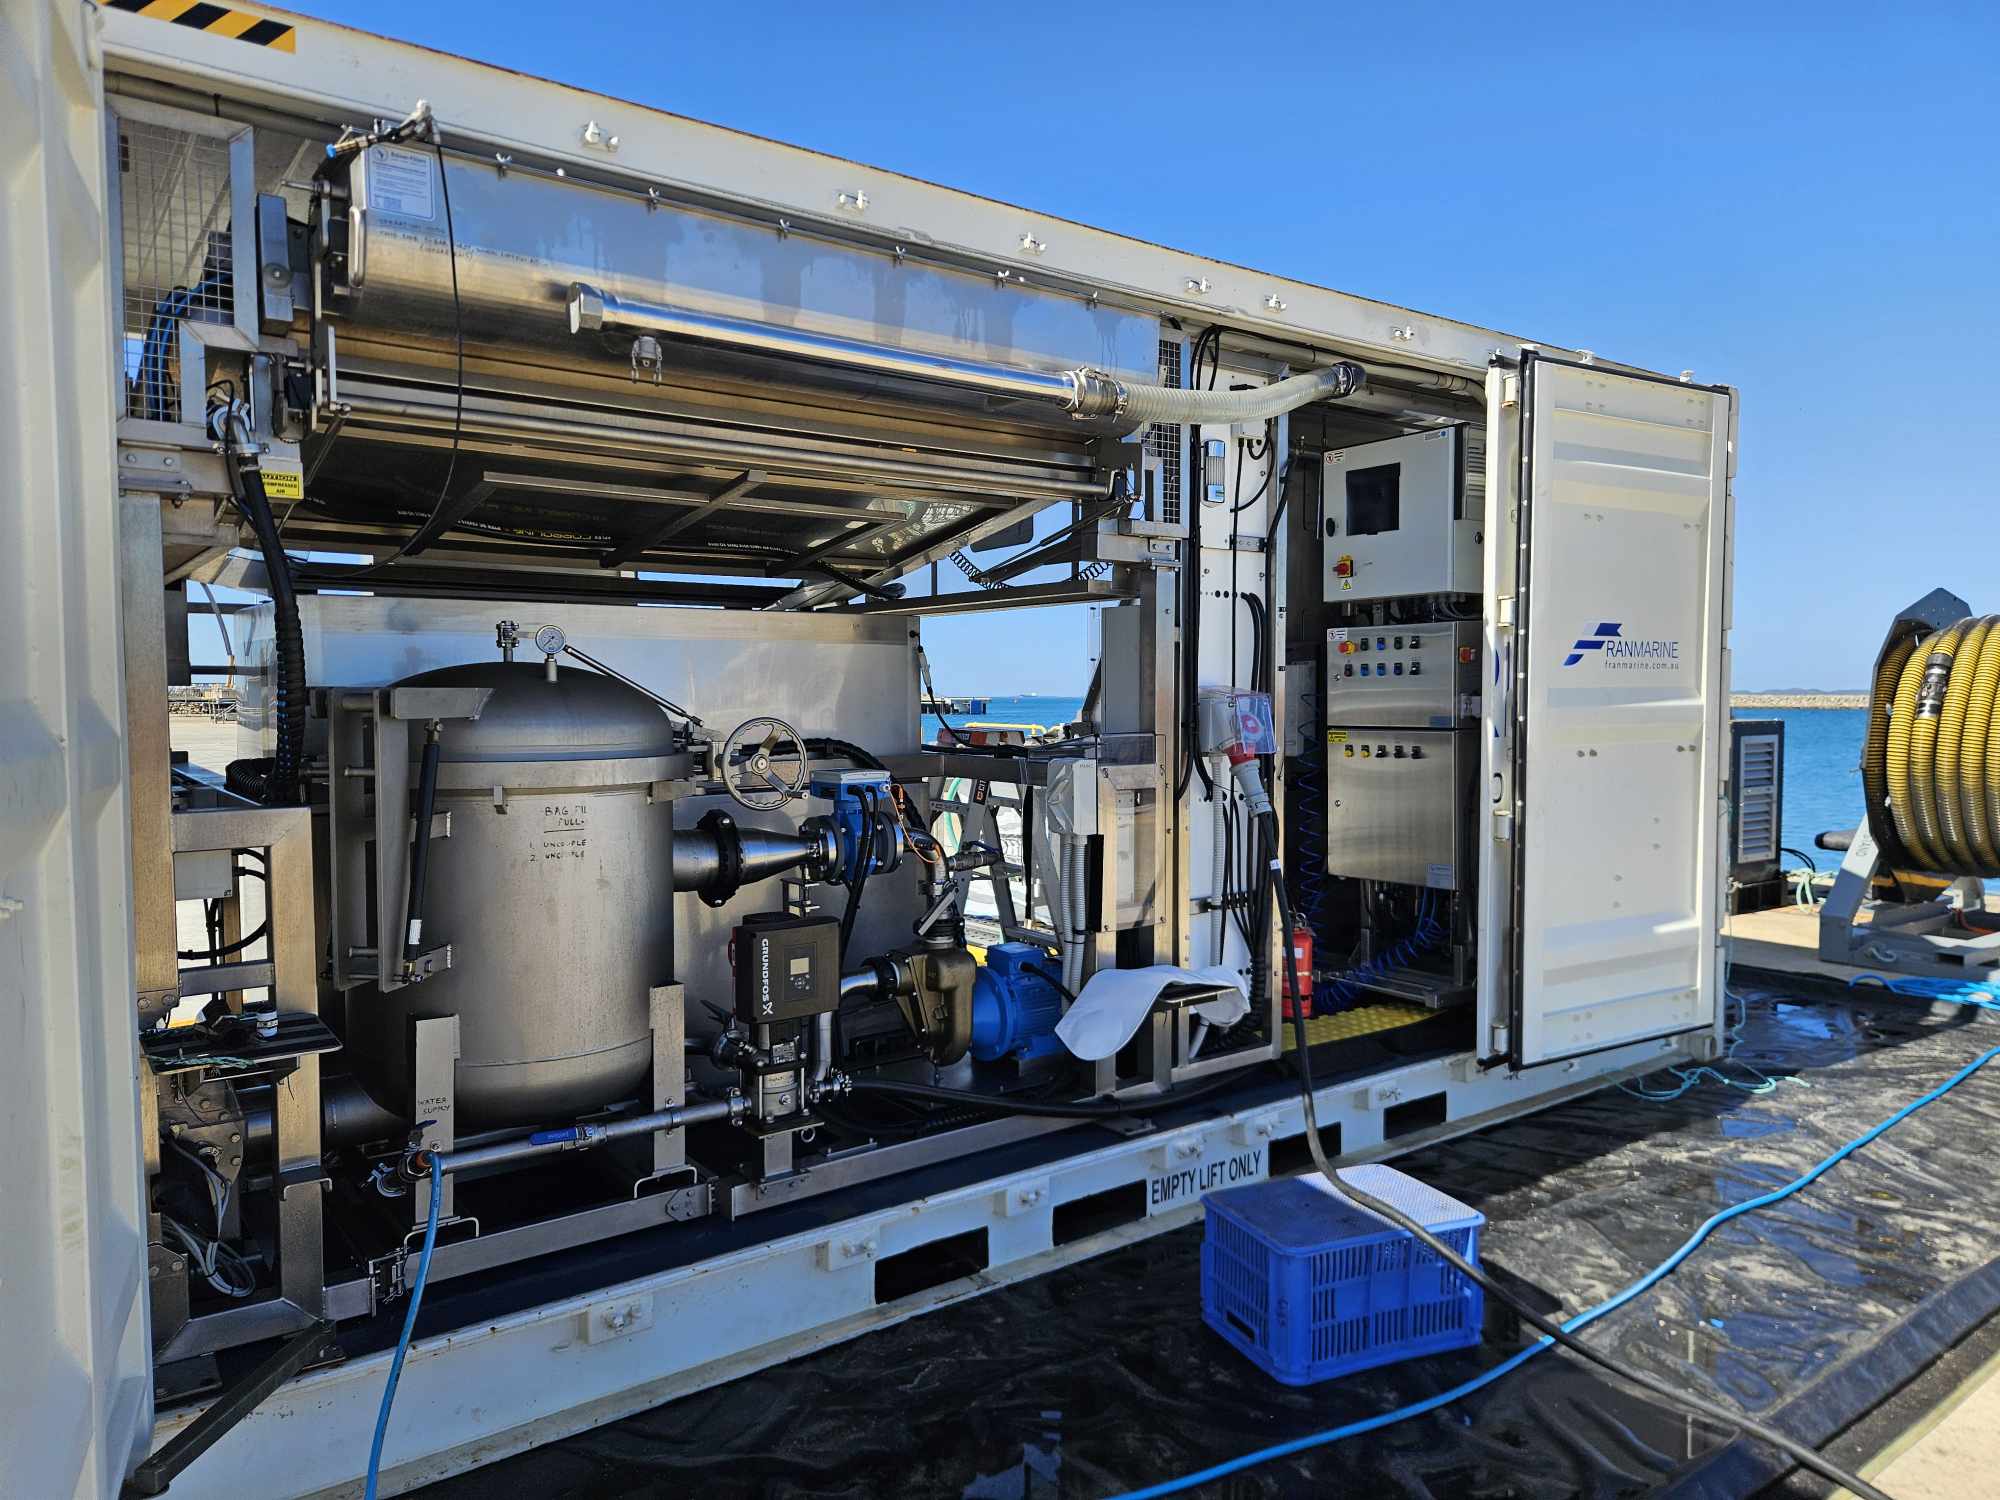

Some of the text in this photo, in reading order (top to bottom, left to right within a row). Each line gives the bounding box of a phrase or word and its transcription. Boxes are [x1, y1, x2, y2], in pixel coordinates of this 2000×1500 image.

[1605, 661, 1679, 670] franmarine.com.au
[544, 806, 569, 816] BAG
[761, 938, 769, 1002] GRUNDFOS
[1151, 1149, 1261, 1204] EMPTY LIFT ONLY
